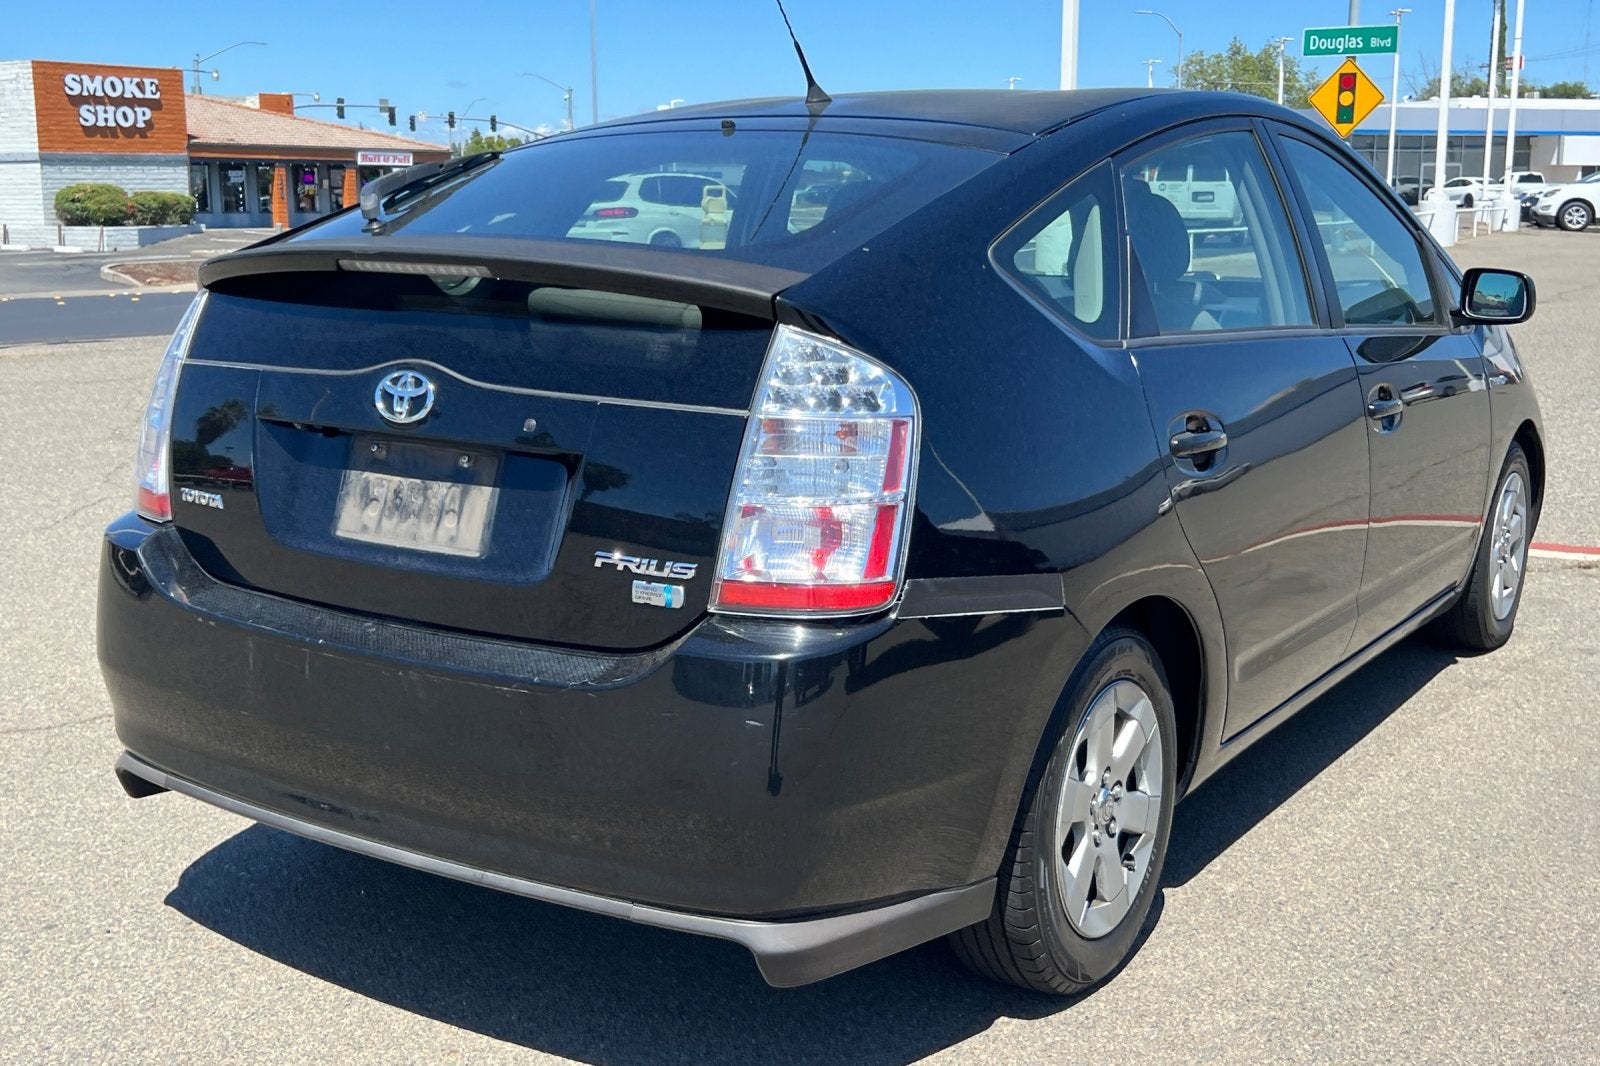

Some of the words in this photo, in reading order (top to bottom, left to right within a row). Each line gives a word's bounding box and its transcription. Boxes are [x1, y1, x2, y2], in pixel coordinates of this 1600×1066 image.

[1309, 34, 1363, 53] Douglas
[1370, 37, 1392, 48] Blvd
[63, 73, 161, 100] SMOKE
[78, 104, 152, 128] SHOP
[180, 487, 224, 510] TOYOTA
[594, 550, 698, 580] PRIUS
